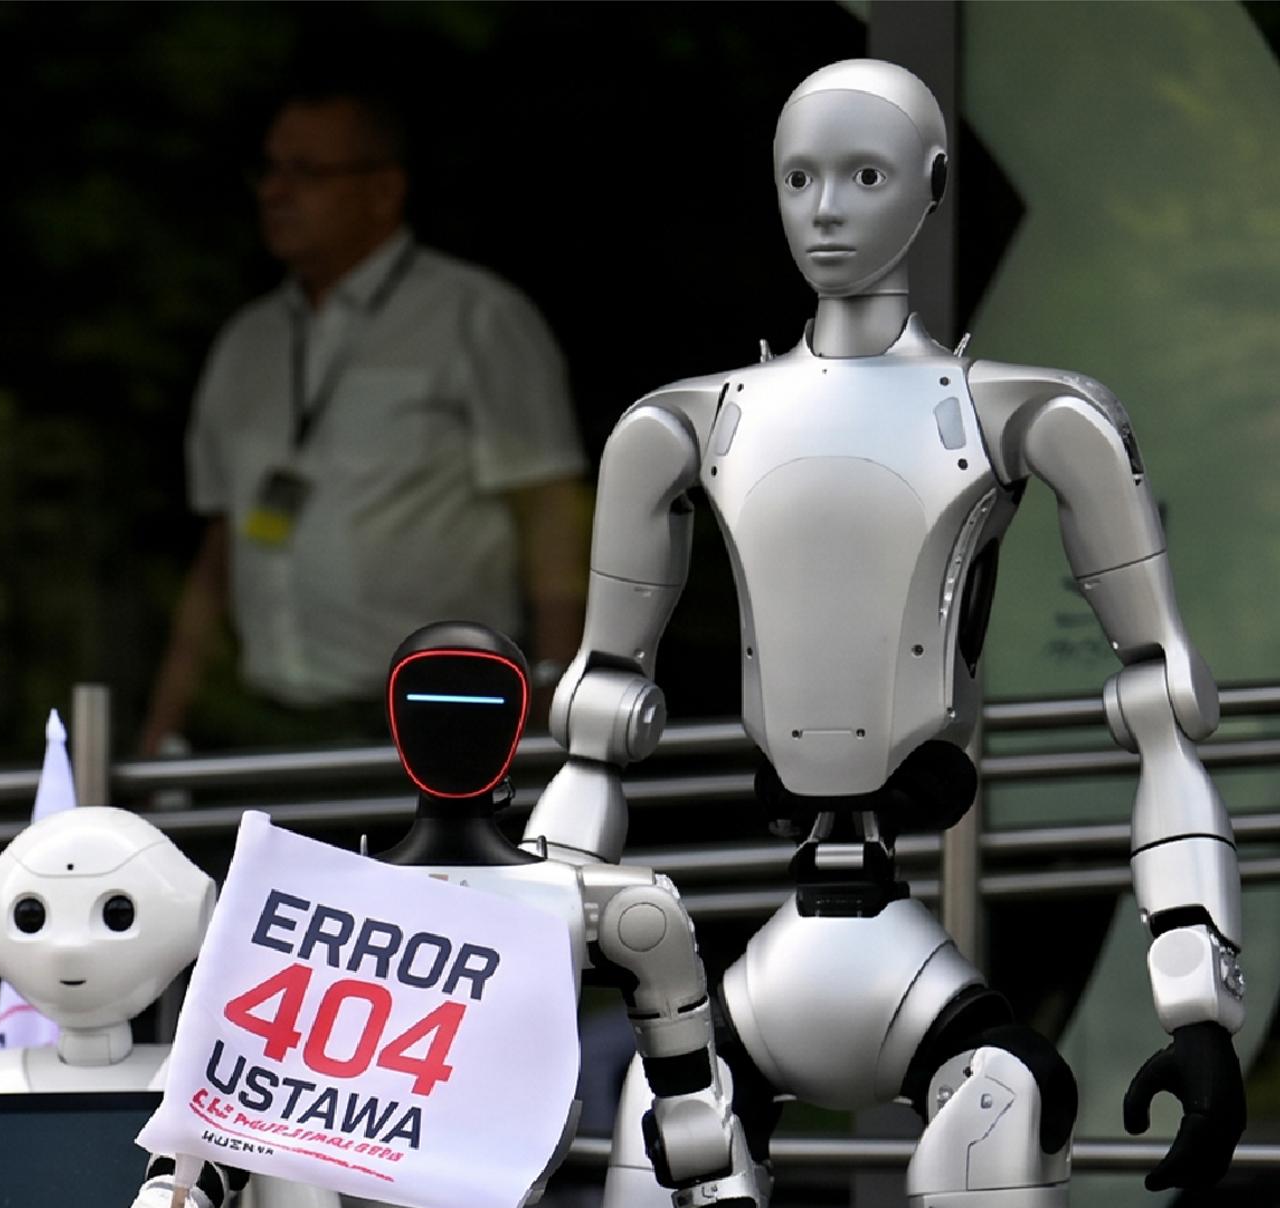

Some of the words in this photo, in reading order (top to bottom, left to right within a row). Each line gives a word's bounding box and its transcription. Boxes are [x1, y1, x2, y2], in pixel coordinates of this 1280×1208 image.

[250, 888, 501, 1001] ERROR
[223, 962, 468, 1097] 404
[204, 1039, 422, 1149] USTAWA
